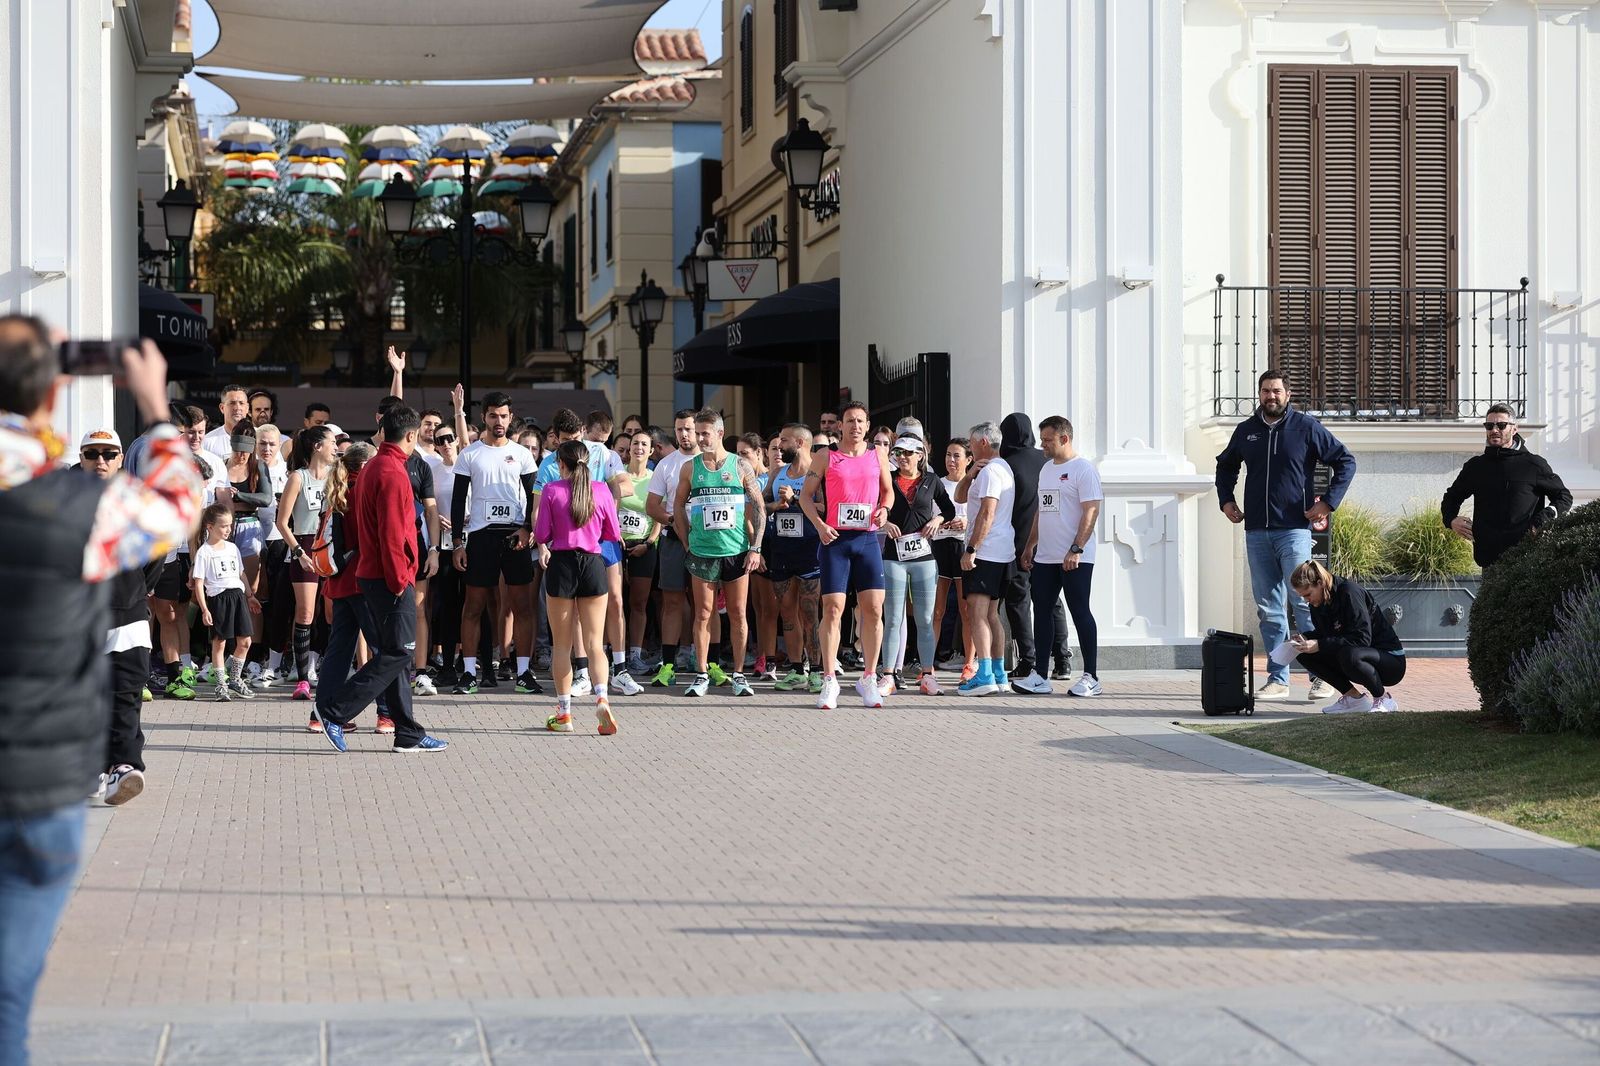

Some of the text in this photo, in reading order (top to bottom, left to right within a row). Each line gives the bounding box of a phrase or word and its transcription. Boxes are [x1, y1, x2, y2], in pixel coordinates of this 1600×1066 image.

[699, 487, 732, 495] ATLETISMO
[1042, 494, 1053, 506] 30
[492, 505, 510, 517] 284
[711, 510, 728, 522] 179
[846, 509, 865, 521] 240
[623, 515, 640, 527] 265
[781, 518, 796, 530] 169
[904, 539, 922, 552] 425
